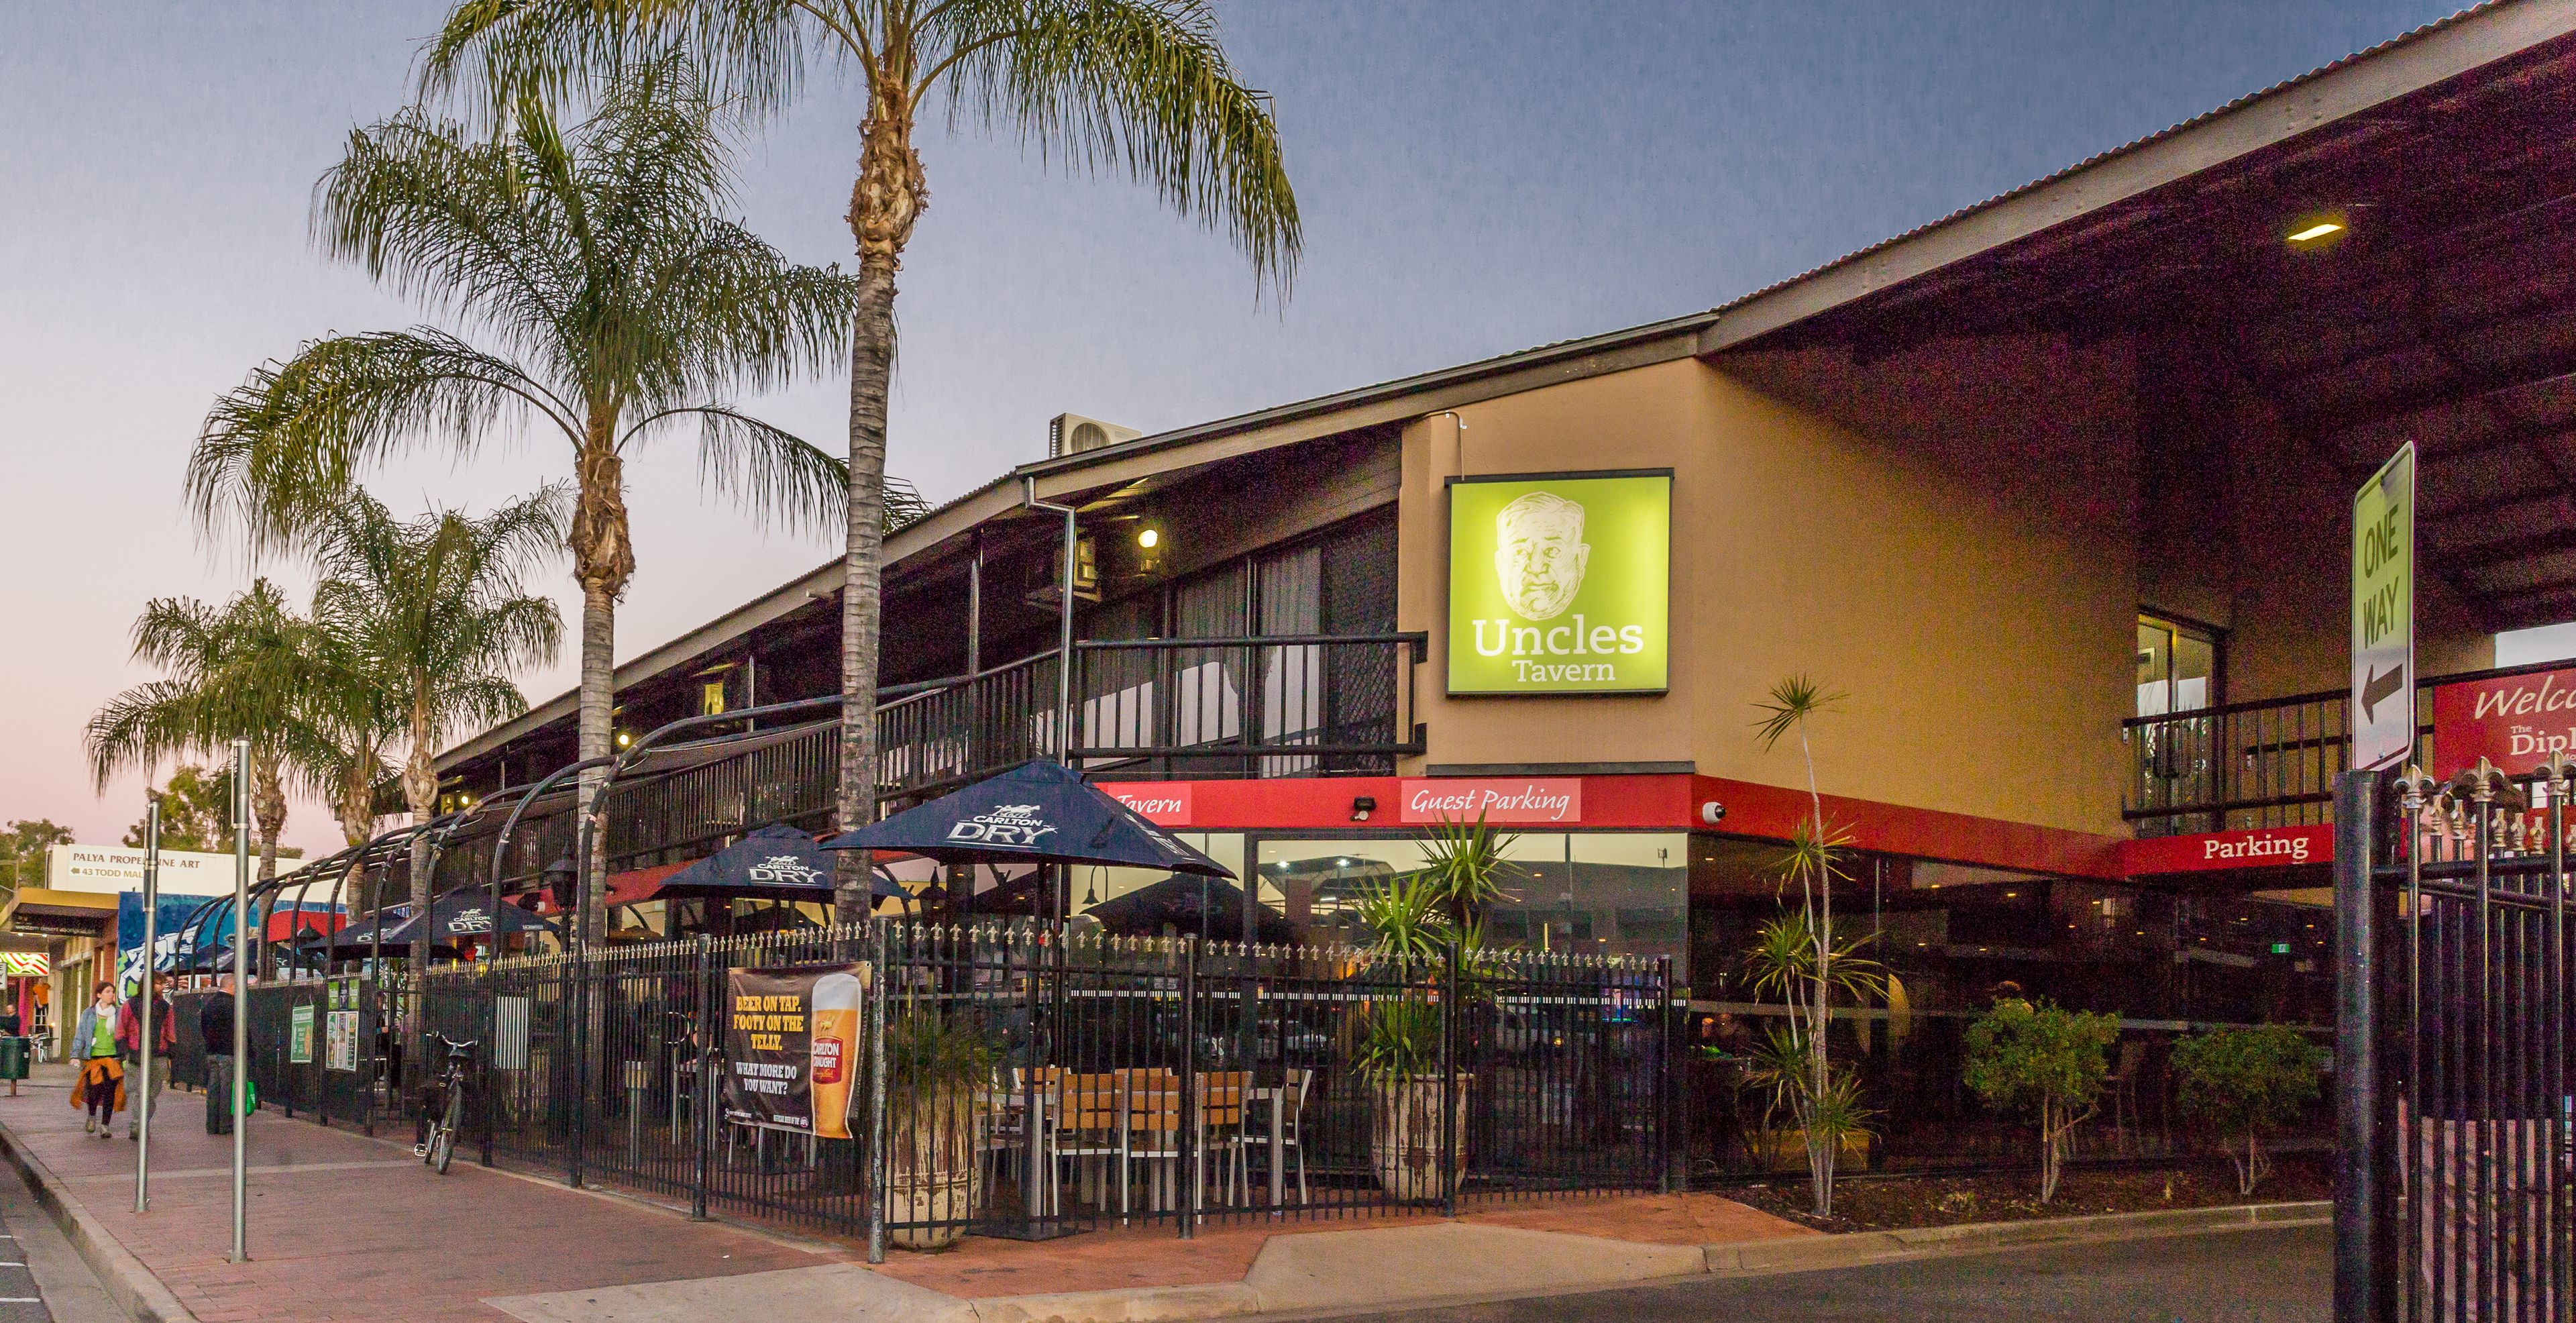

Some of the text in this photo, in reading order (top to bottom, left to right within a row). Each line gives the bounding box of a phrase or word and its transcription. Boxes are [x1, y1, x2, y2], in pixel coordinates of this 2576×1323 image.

[2364, 504, 2398, 578] ONE
[2363, 576, 2399, 649] WAY
[1472, 614, 1644, 656] Uncles
[1512, 659, 1615, 682] Tavern
[2510, 725, 2532, 734] The
[1117, 794, 1181, 813] Tavern
[1411, 785, 1570, 821] Guest Parking
[973, 815, 1043, 827] CARLTON
[946, 822, 1058, 845] DRY
[2204, 834, 2308, 859] Parking
[73, 853, 201, 869] PALYA PROPE INE ART
[95, 869, 121, 877] TODD
[123, 870, 144, 879] MAL
[749, 868, 825, 884] DRY
[736, 996, 801, 1012] BEER ON TAP.
[733, 1014, 804, 1032] FOOTY ON THE
[751, 1034, 783, 1051] TELLY.
[736, 1061, 759, 1076] WHAT
[759, 1063, 784, 1079] MORE
[785, 1065, 797, 1079] DO
[744, 1079, 788, 1095] YOU WANT?
